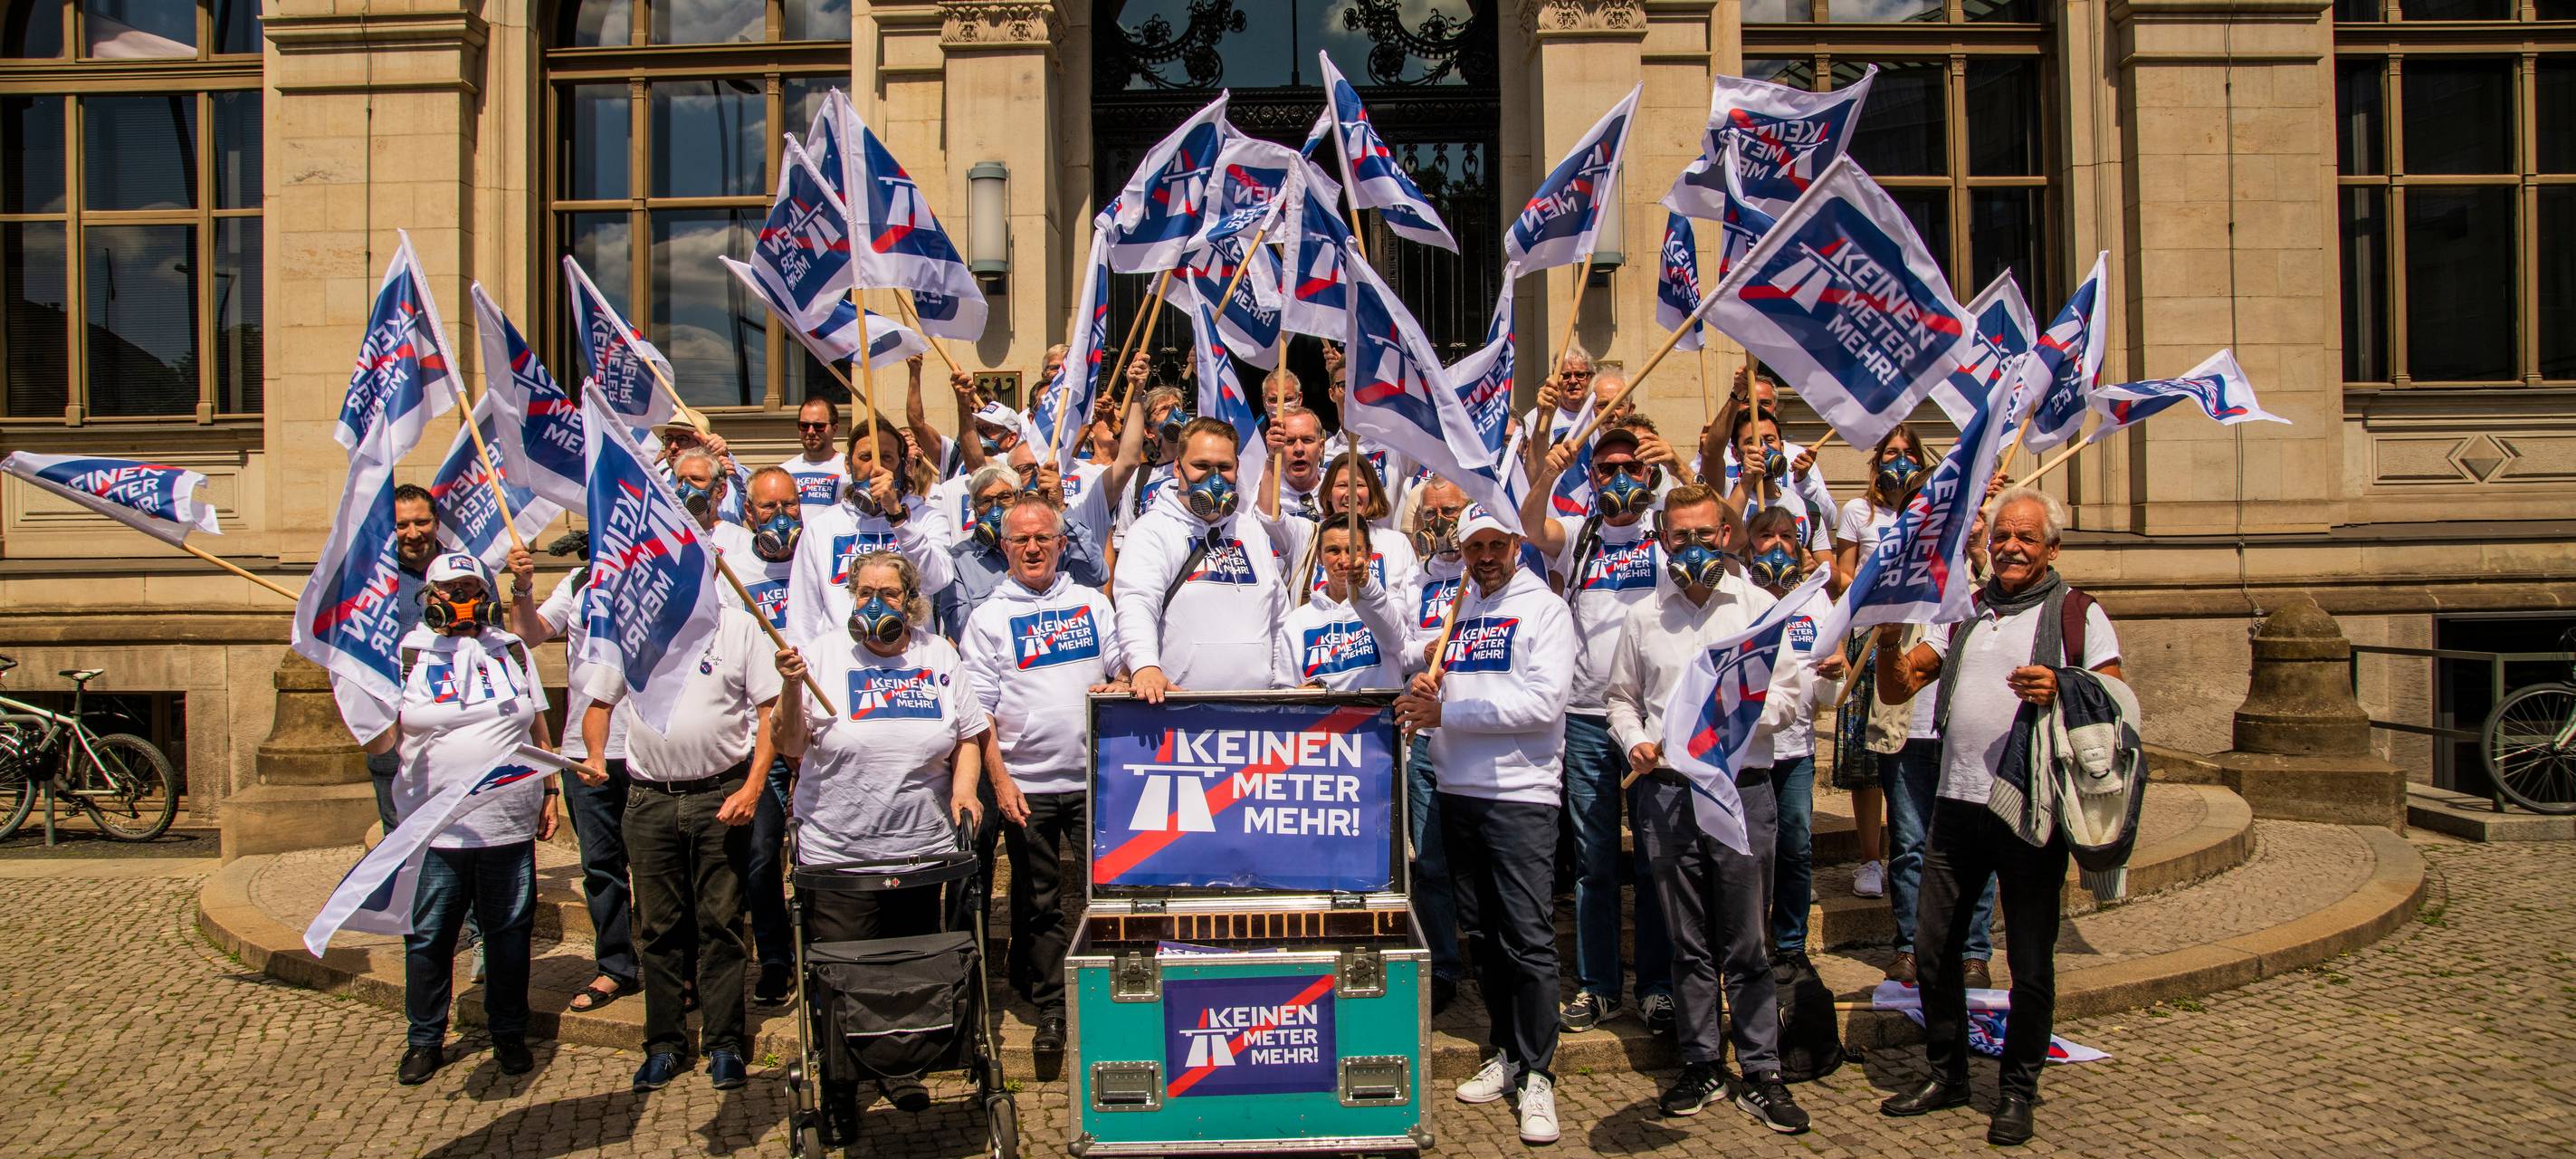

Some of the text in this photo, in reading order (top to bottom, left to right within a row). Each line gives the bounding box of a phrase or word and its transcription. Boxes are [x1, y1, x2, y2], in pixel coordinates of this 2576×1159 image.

[1831, 242, 1936, 351] KEINEN
[1838, 290, 1915, 367] METER
[1826, 314, 1900, 386] MEHR!
[797, 477, 835, 486] KEINEN
[807, 484, 833, 493] METER
[1614, 560, 1650, 570] METER
[1617, 570, 1651, 580] MEHR!
[1032, 616, 1090, 636] KEINEN
[1053, 627, 1092, 641] METER
[1058, 637, 1093, 652] MEHR!
[1337, 636, 1371, 652] METER
[1471, 639, 1504, 649] METER
[1340, 646, 1374, 662] MEHR!
[1473, 649, 1504, 661] MEHR!
[892, 689, 923, 699] METE
[897, 699, 934, 709] MEHR!
[1178, 728, 1361, 768] KEINEN
[1233, 772, 1360, 802] METER
[1244, 807, 1360, 837] MEHR!
[1209, 1004, 1318, 1028] KEINEN
[1243, 1029, 1317, 1047] METER
[1251, 1046, 1319, 1065] MEHR!
